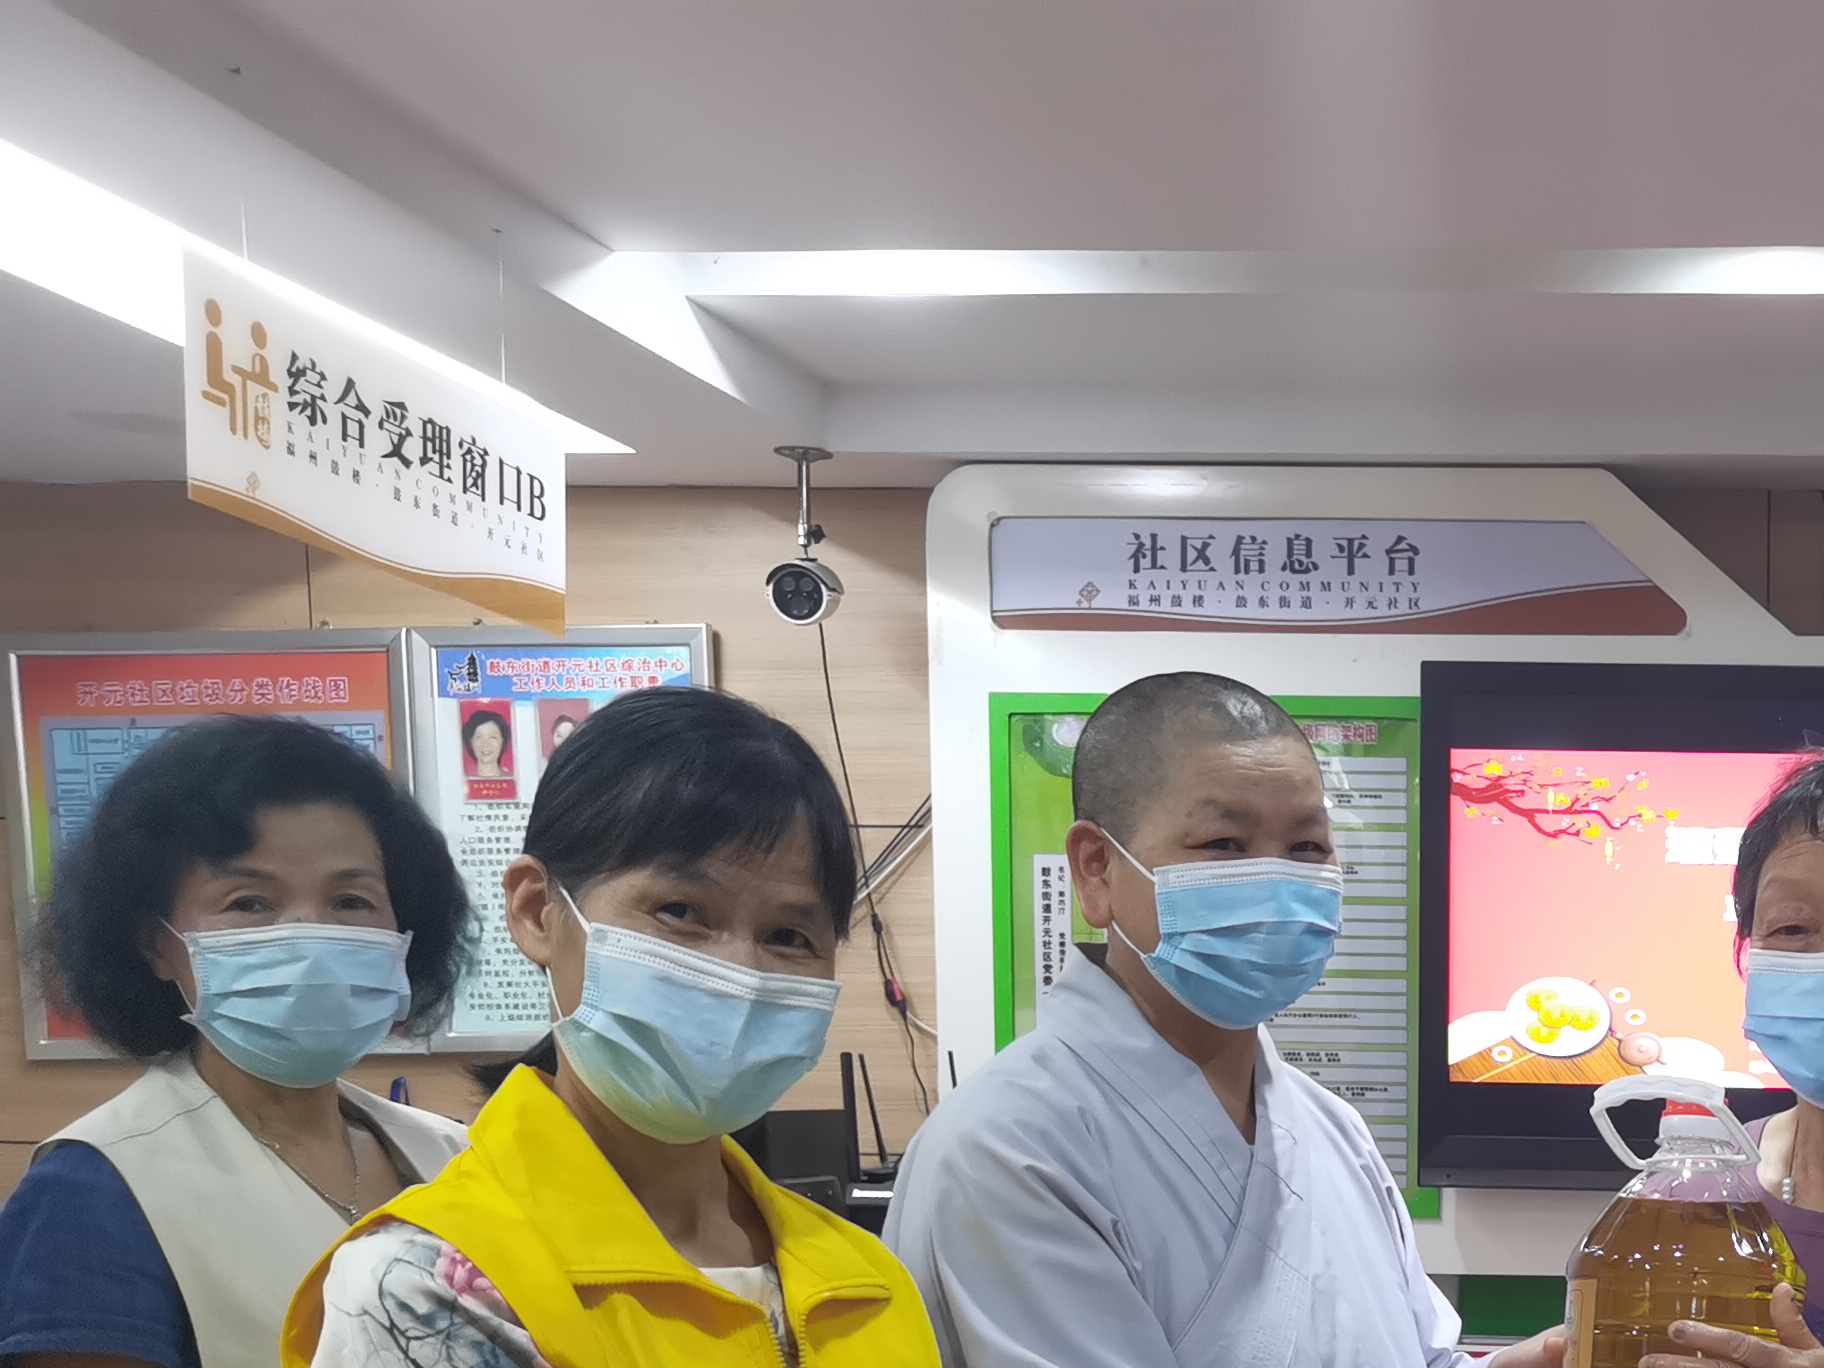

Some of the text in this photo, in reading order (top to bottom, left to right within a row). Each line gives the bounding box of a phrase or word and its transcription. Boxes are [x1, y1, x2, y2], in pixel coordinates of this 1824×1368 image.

[286, 350, 547, 522] 综合受理窗口B
[286, 421, 545, 545] KAIYUAN COMMUNITY
[1126, 532, 1421, 577] 社区信息平台
[1127, 579, 1422, 593] KAIYUAN COMMUNITY
[486, 657, 686, 676] 鼓东街道开元社区综治中心
[75, 676, 349, 707] 开元社区垃圾分类作战图
[512, 674, 662, 693] 工作人员和工作职责
